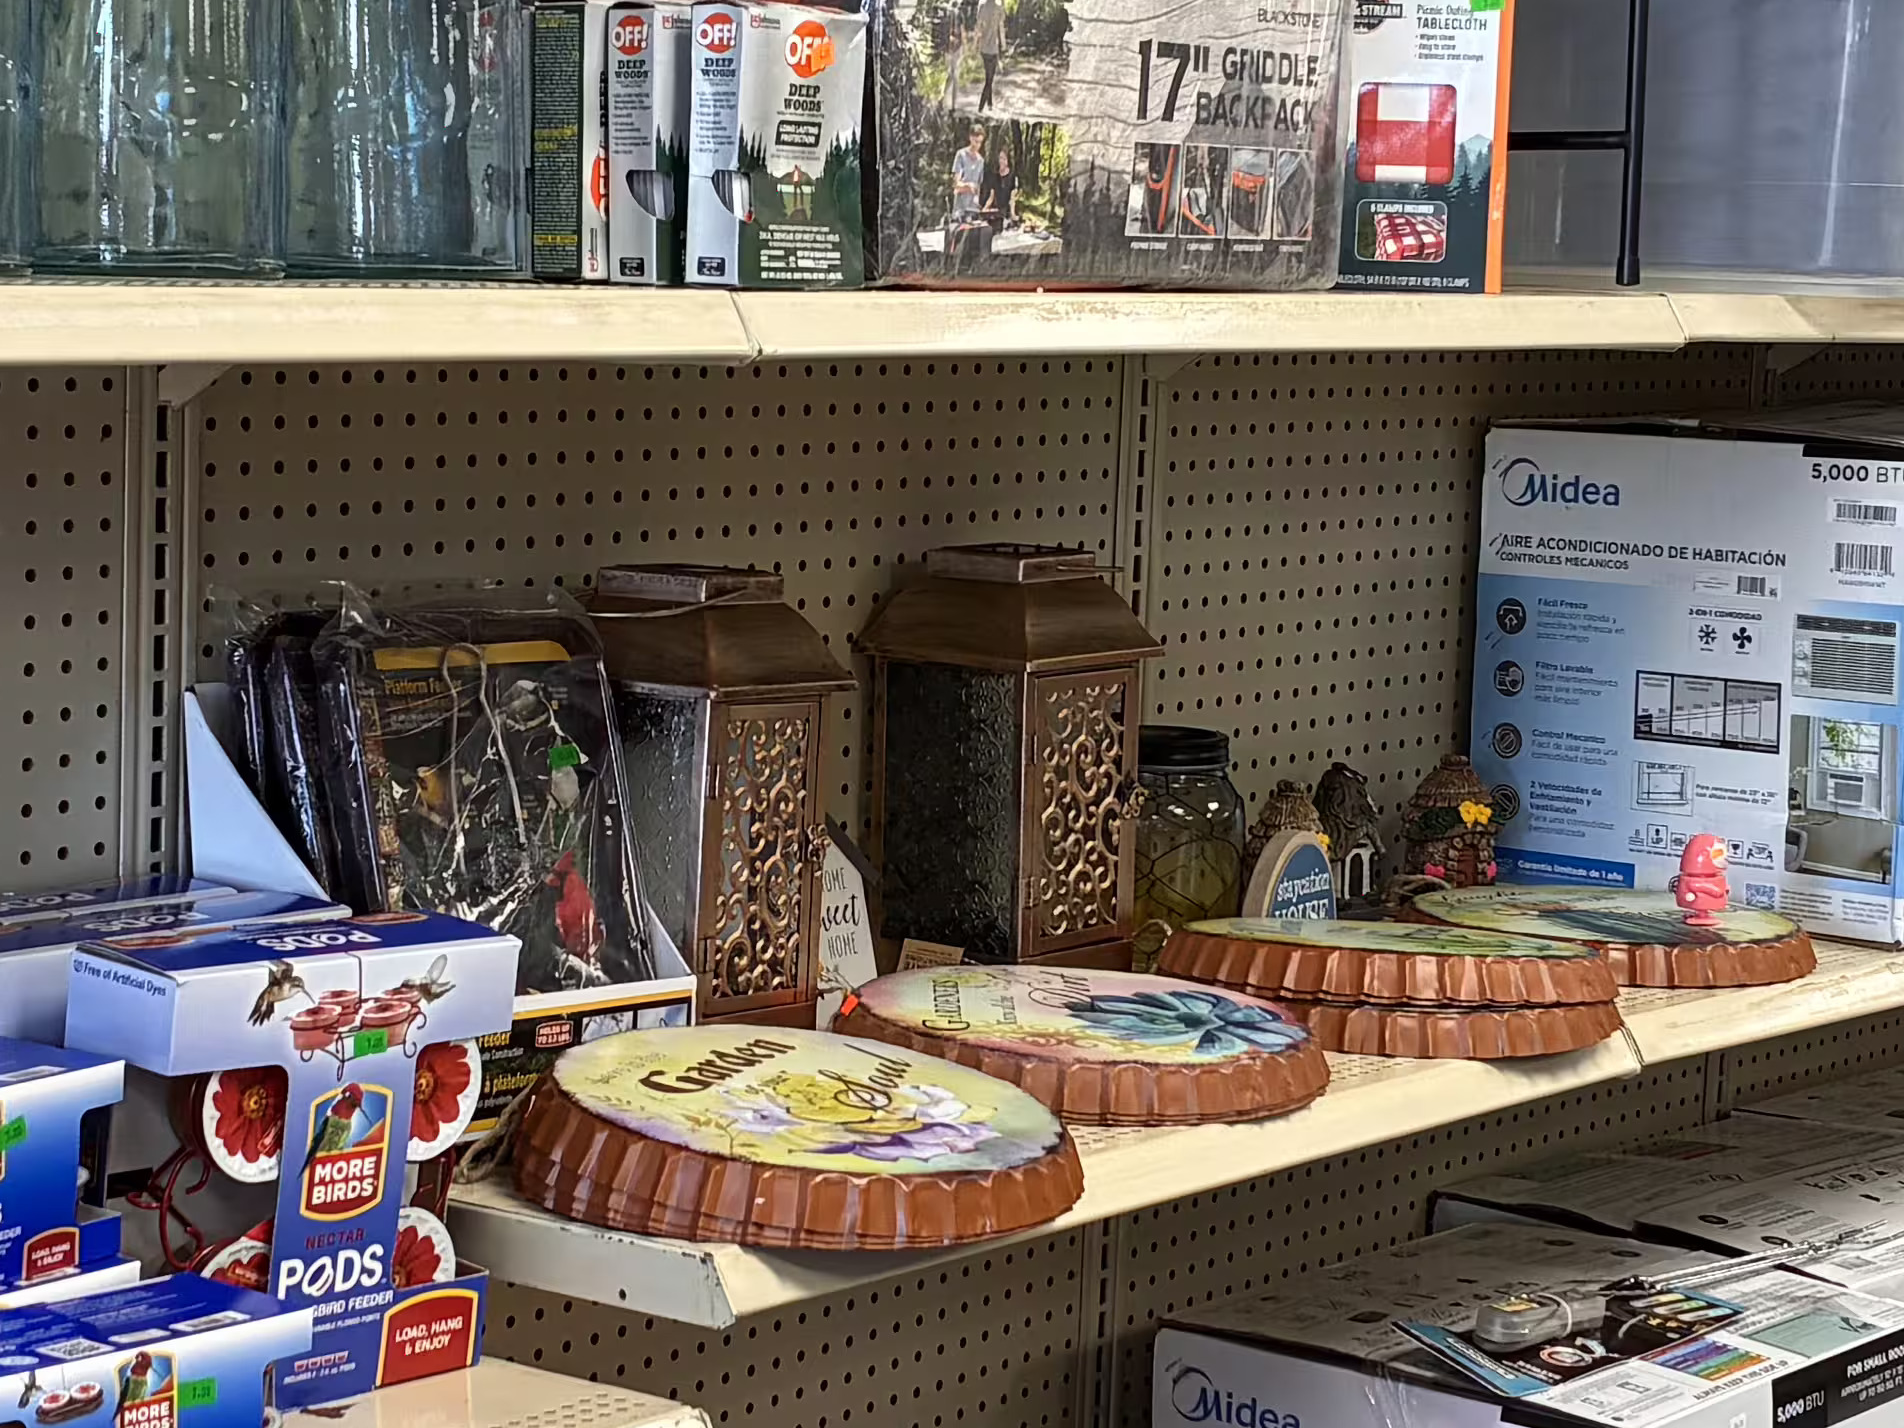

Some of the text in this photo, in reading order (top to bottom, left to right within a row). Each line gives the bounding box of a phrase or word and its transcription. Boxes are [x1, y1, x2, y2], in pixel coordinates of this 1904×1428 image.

[1257, 7, 1321, 29] BLACKSTONE
[1416, 3, 1443, 16] Picnic
[696, 21, 737, 48] OFF!
[1416, 16, 1488, 32] TABLECLOTH
[611, 25, 648, 49] OFF!
[617, 59, 646, 70] DEEP
[1222, 46, 1318, 87] GRIDDLE
[788, 83, 821, 98] DEEP
[783, 98, 824, 113] WOODS
[1195, 92, 1316, 134] BACKPACK
[1502, 458, 1621, 508] Midea
[1810, 462, 1870, 482] 5,000
[1499, 550, 1630, 571] CONTROLES MECANICOS
[1500, 532, 1787, 568] AIRE ACONDICIONADO DE HABITACIÓN
[383, 679, 428, 695] Platform
[1275, 869, 1332, 905] staycation
[1273, 899, 1329, 920] HOUSE
[256, 927, 384, 953] PODS
[827, 931, 859, 960] HOME
[637, 1037, 797, 1095] Garden
[313, 1155, 377, 1184] MORE
[310, 1181, 376, 1206] BIRDS
[304, 1227, 366, 1251] NECTAR
[277, 1243, 385, 1301] PODS
[347, 1289, 395, 1312] FEEDER
[430, 1315, 463, 1333] HANG
[414, 1332, 451, 1354] ENJOY
[123, 1400, 171, 1425] MORE
[1805, 1390, 1826, 1412] BTU
